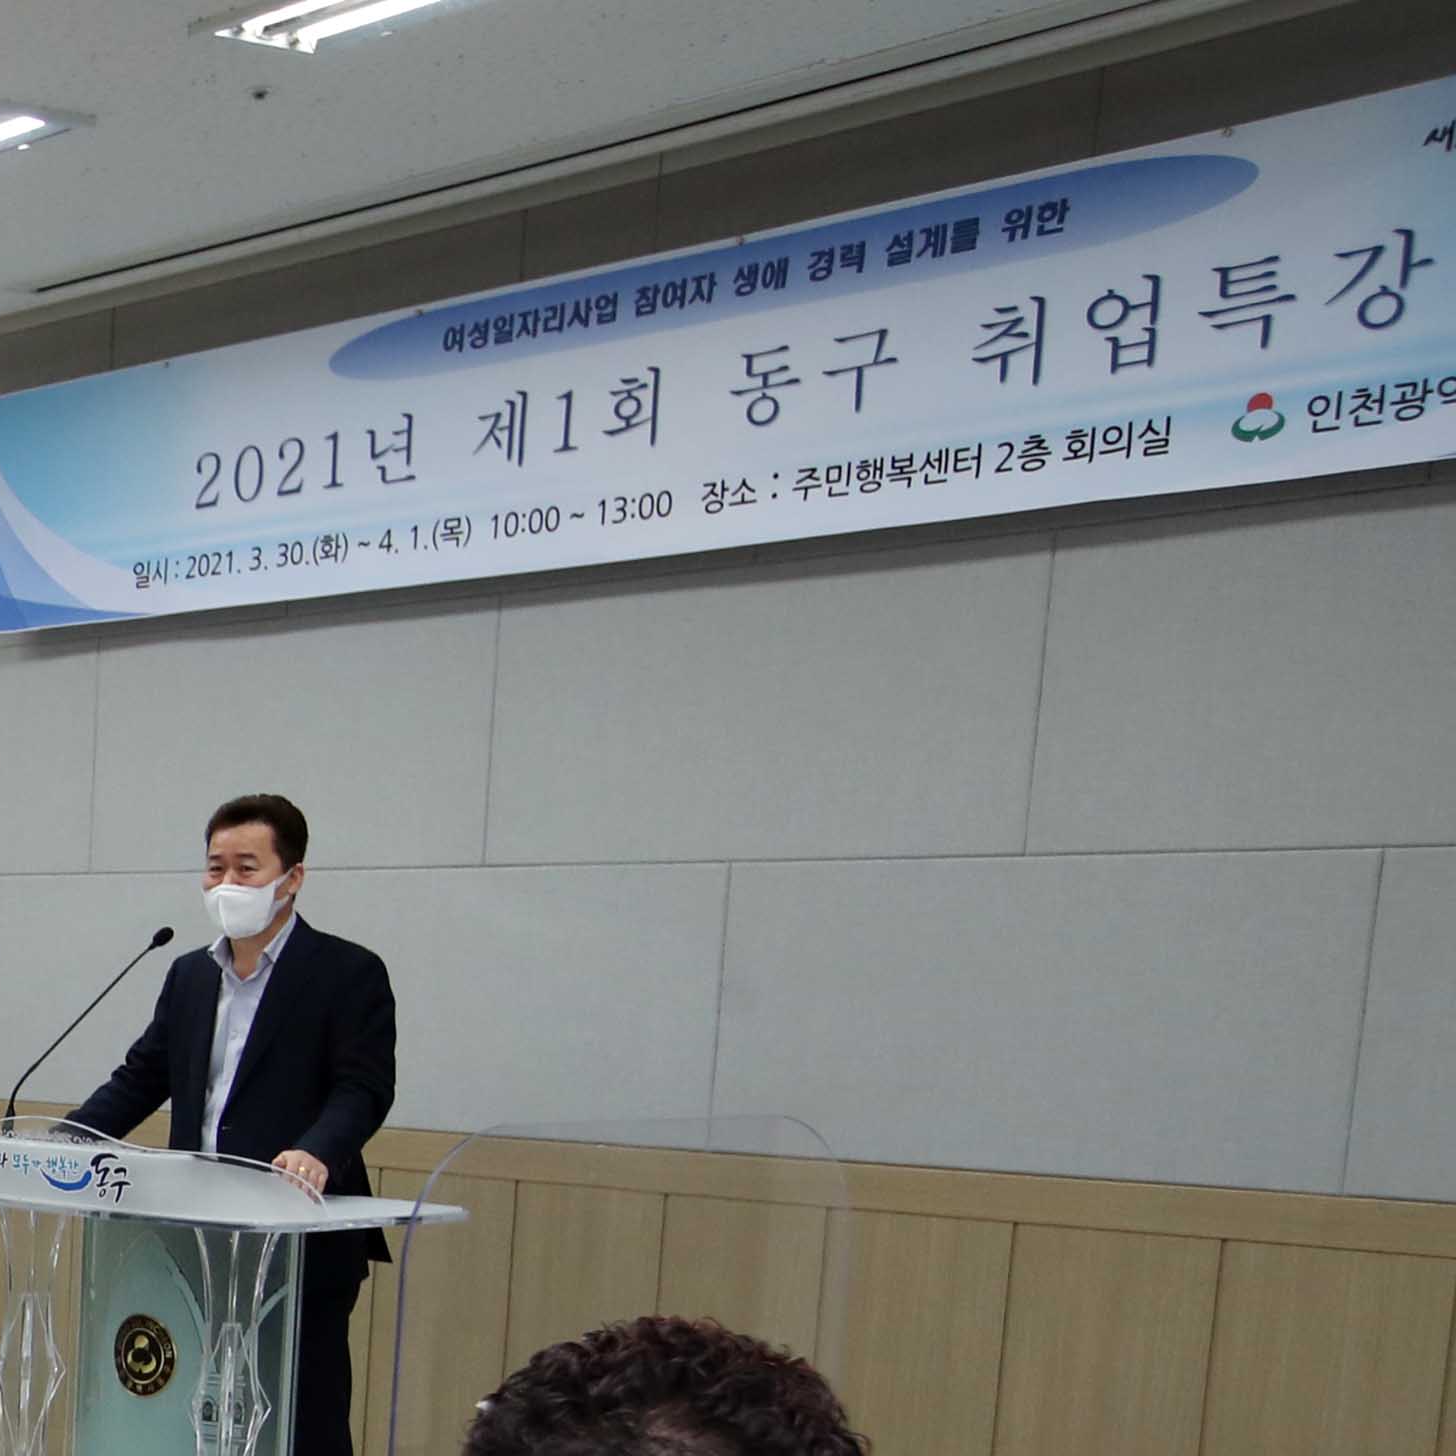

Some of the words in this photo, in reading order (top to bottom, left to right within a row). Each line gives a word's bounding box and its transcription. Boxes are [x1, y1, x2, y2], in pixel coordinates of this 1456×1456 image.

[442, 293, 619, 353] 여성일자리사업
[633, 271, 717, 317] 참여자
[733, 257, 788, 299] 생애
[807, 240, 867, 282] 경력
[886, 216, 981, 268] 설계를
[1001, 197, 1071, 244] 위한
[195, 412, 417, 510] 2021년
[472, 366, 661, 468] 제1회
[730, 327, 899, 427] 동구
[971, 227, 1434, 387] 취업특강
[490, 505, 561, 539] 10:00
[597, 490, 674, 526] 13:00
[701, 478, 757, 514] 장소
[792, 442, 983, 500] 주민행복센터
[994, 433, 1052, 475] 2층
[1062, 415, 1172, 464] 회의실
[90, 1152, 132, 1203] 동구
